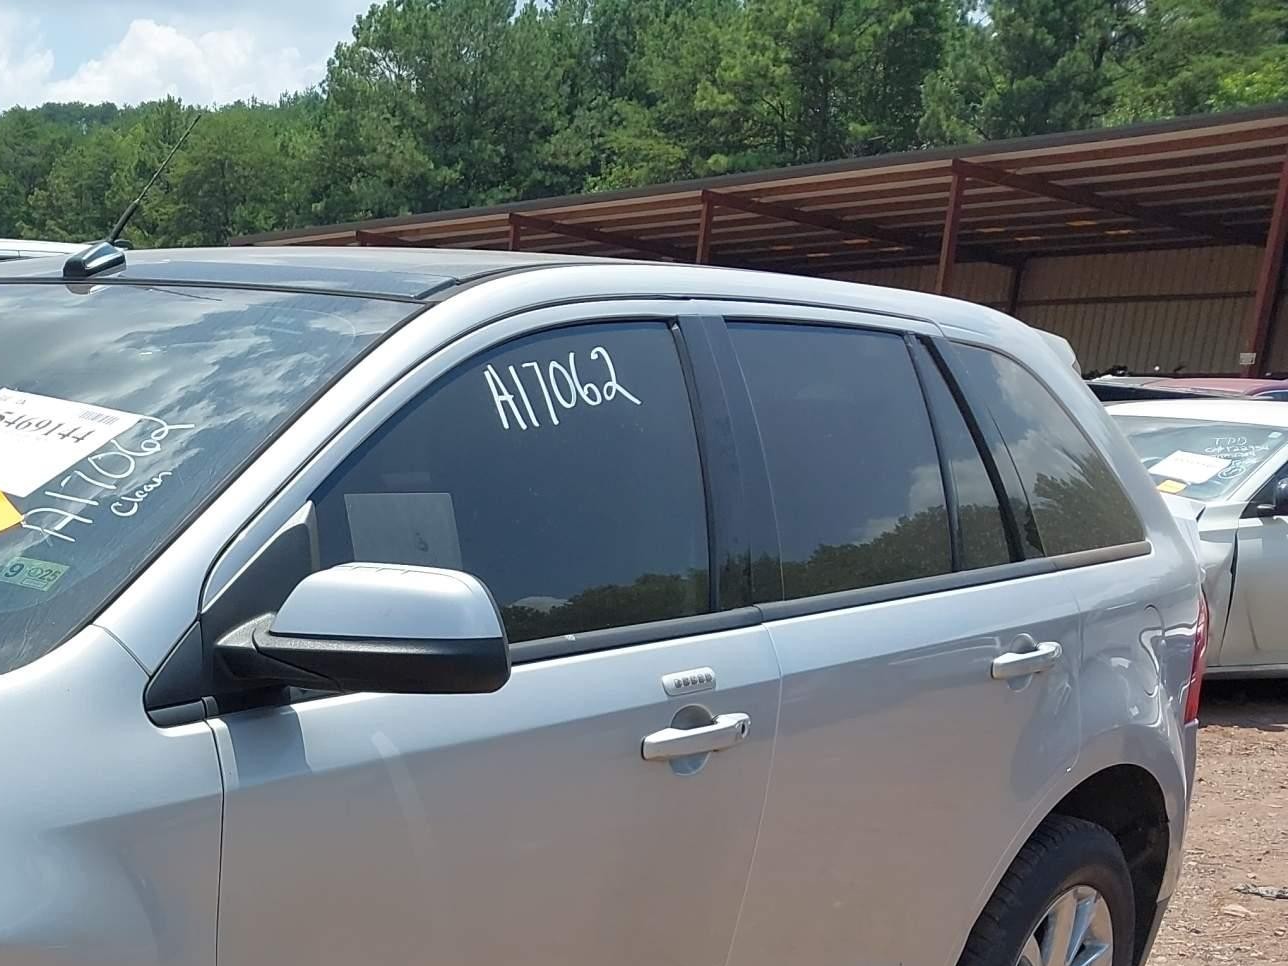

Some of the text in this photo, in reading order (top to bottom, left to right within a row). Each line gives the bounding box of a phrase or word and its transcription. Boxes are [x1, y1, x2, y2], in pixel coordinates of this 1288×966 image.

[484, 346, 642, 430] A17062
[21, 415, 195, 542] A17062
[111, 471, 173, 516] Clean
[4, 563, 25, 578] 9
